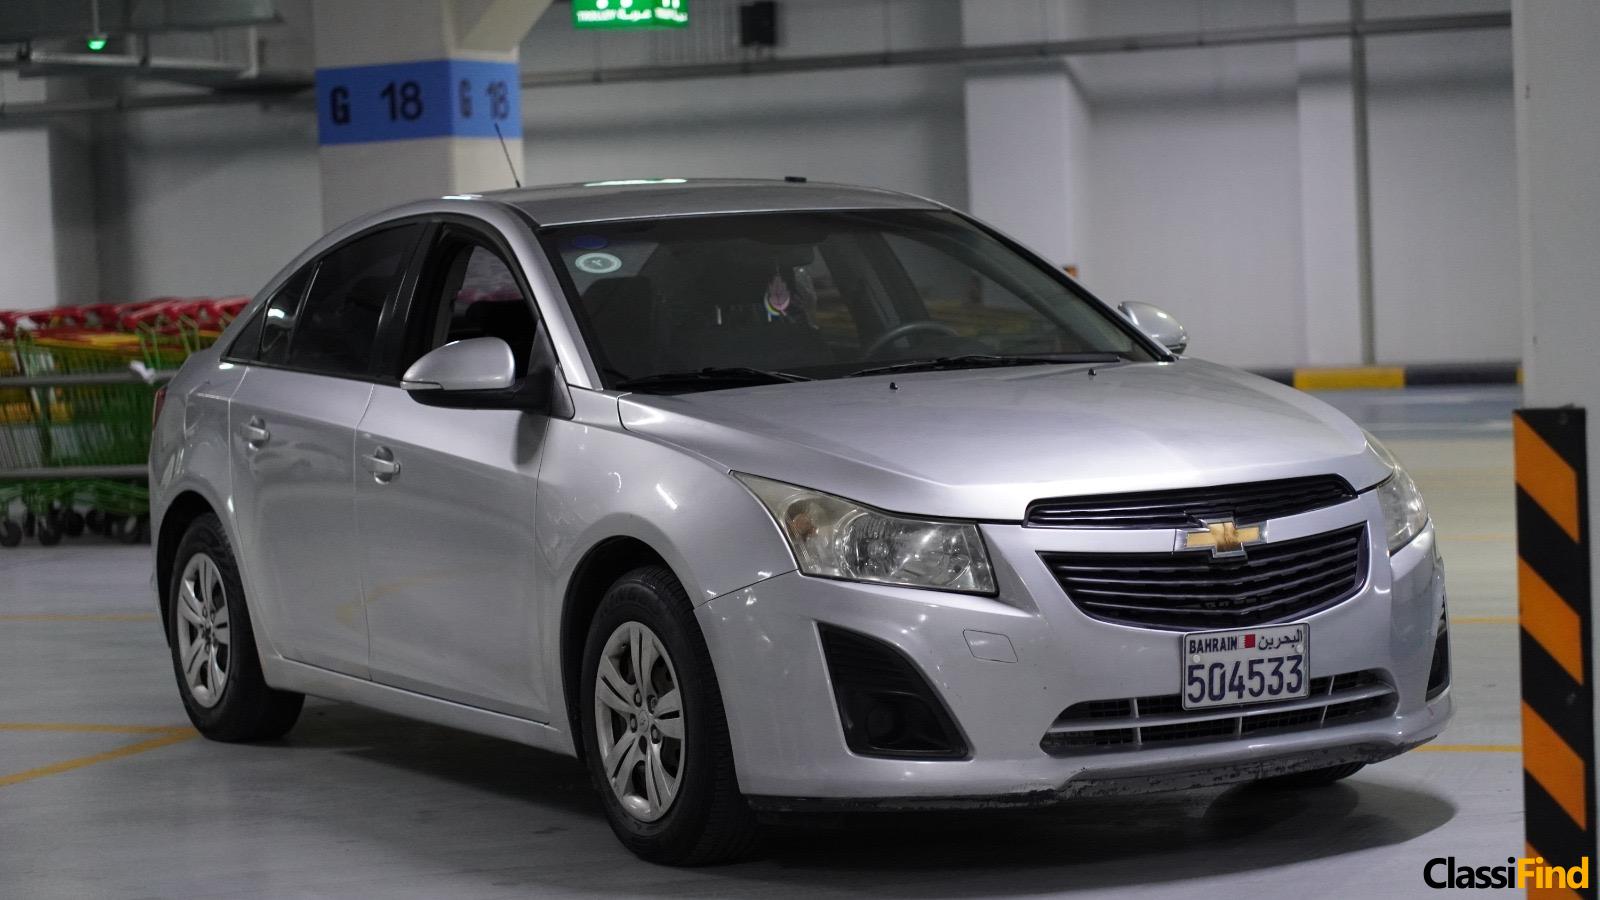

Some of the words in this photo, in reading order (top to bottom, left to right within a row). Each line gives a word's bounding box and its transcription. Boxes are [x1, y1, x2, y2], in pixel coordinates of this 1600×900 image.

[329, 85, 352, 125] G
[379, 80, 424, 122] 18
[1189, 636, 1238, 654] BAHRAIN
[1258, 629, 1303, 650] البحرين
[1187, 655, 1303, 704] 504533
